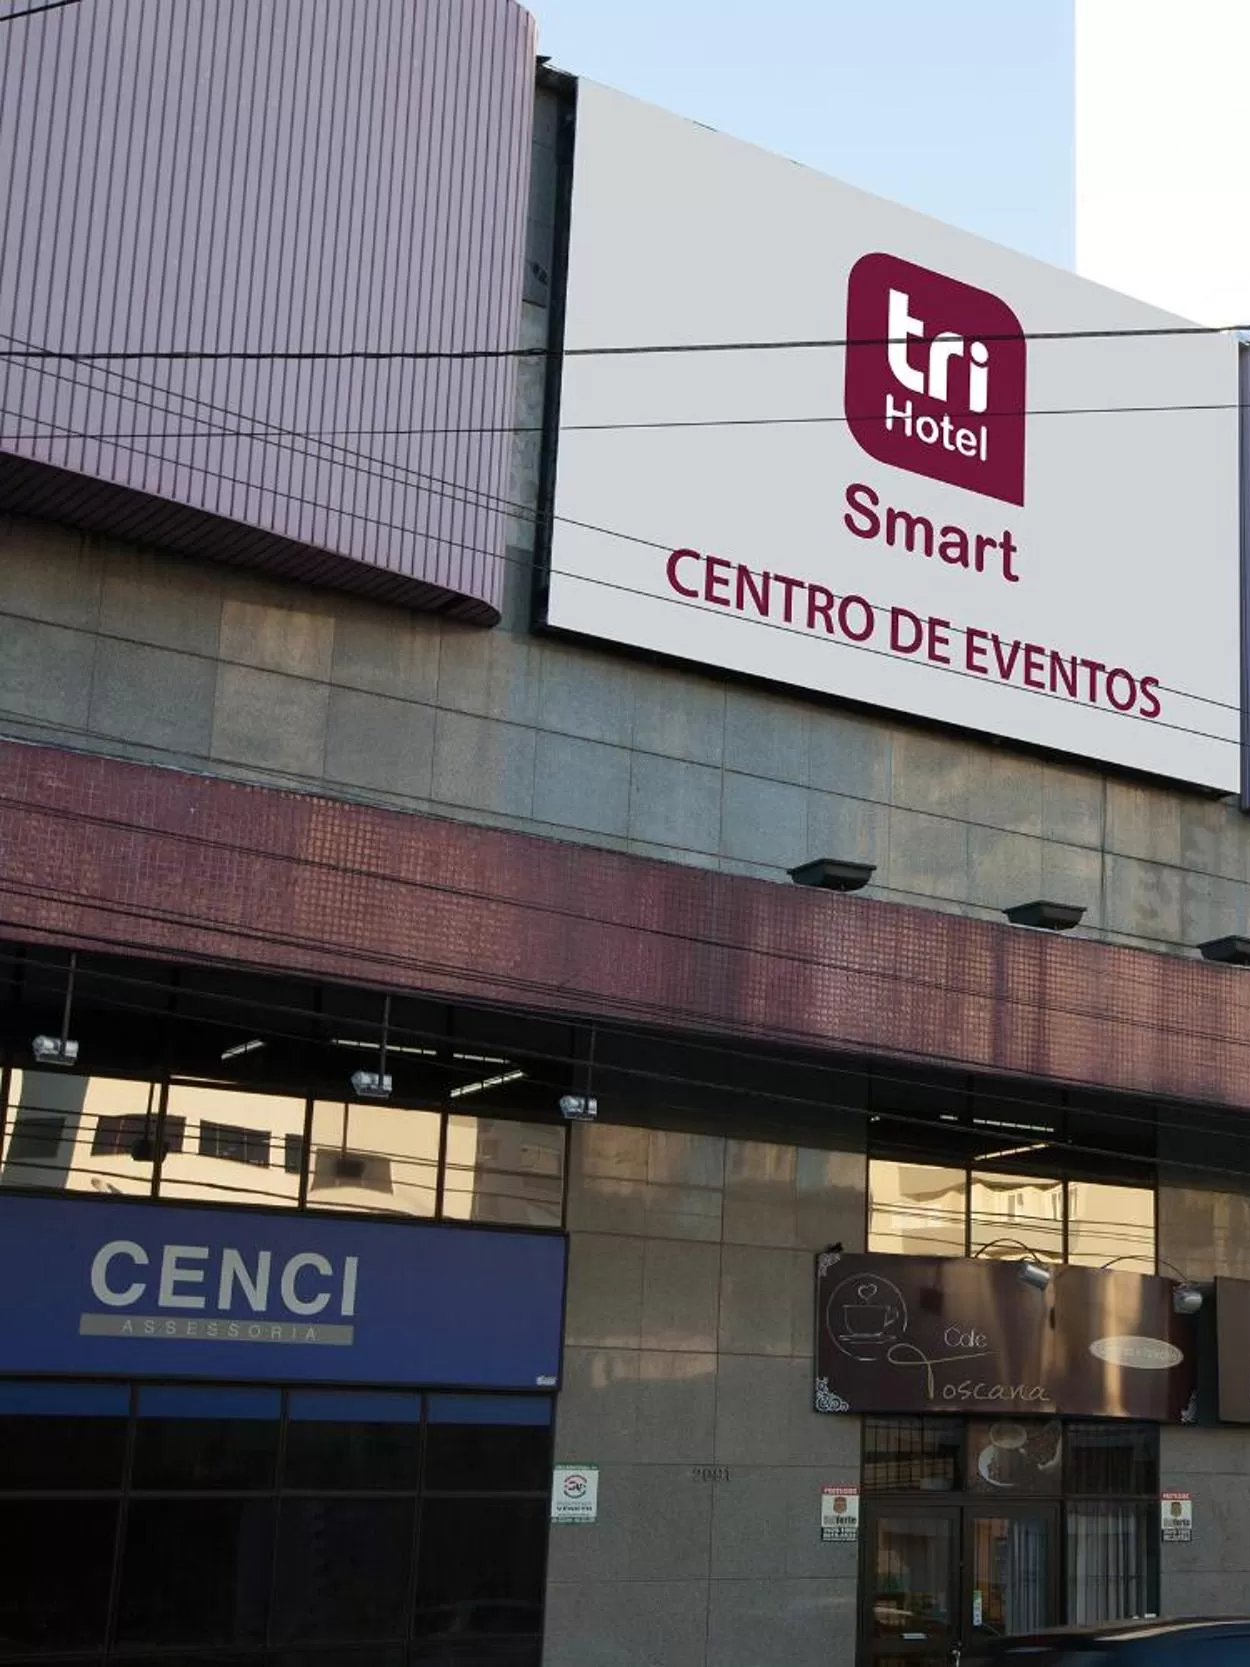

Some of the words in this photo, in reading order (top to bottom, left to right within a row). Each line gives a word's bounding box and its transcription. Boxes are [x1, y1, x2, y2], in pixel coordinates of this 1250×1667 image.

[887, 288, 989, 413] tri
[885, 393, 988, 461] Hotel
[844, 482, 1020, 582] Smart
[666, 548, 875, 642] CENTRO
[890, 606, 952, 665] DE
[966, 626, 1163, 718] EVENTOS
[90, 1239, 359, 1316] CENCI
[121, 1319, 319, 1341] ASSESSORIA
